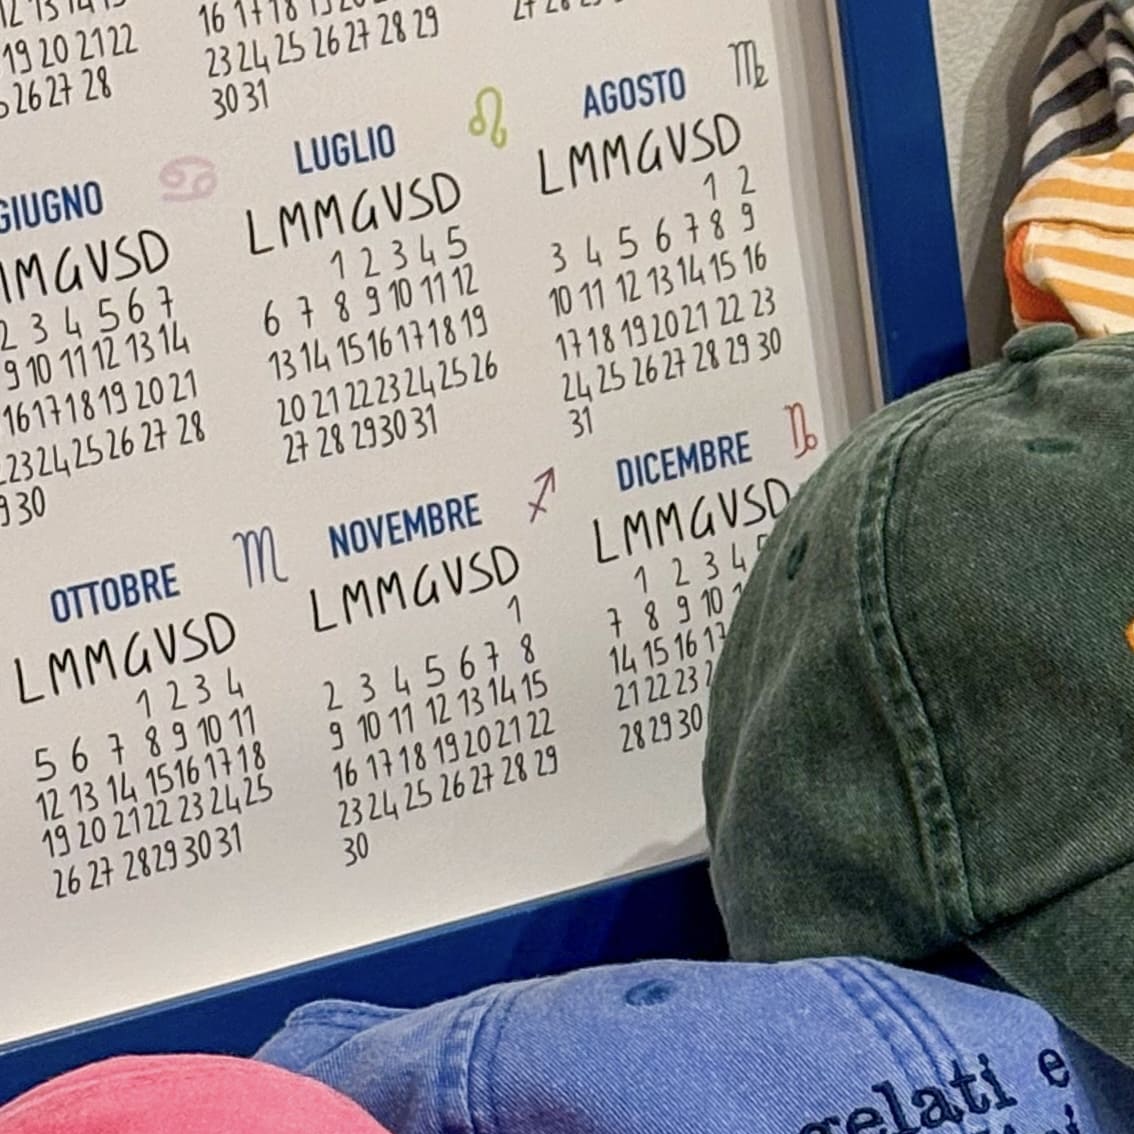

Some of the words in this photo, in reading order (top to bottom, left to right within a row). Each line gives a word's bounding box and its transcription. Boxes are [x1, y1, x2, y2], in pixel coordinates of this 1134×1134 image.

[2, 39, 32, 74] 19
[39, 34, 68, 68] 20
[75, 27, 104, 61] 21
[107, 23, 138, 56] 22
[205, 45, 232, 78] 23
[237, 40, 270, 74] 24
[274, 30, 305, 65] 25
[313, 24, 340, 58] 26
[344, 18, 370, 53] 27
[377, 10, 406, 45] 28
[413, 5, 438, 39] 29
[13, 79, 41, 114] 26
[45, 72, 72, 108] 27
[81, 65, 112, 101] 28
[212, 83, 238, 120] 30
[242, 78, 268, 112] 31
[584, 67, 686, 119] AGOSTO
[294, 124, 395, 175] LUGLIO
[703, 172, 716, 200] 1
[738, 165, 756, 195] 2
[330, 250, 344, 280] 1
[360, 246, 381, 278] 2
[392, 240, 408, 270] 3
[420, 234, 436, 267] 4
[448, 225, 467, 259] 5
[551, 243, 566, 273] 3
[587, 235, 602, 267] 4
[619, 226, 638, 260] 5
[656, 217, 671, 253] 6
[684, 212, 699, 244] 7
[710, 208, 724, 240] 8
[741, 202, 755, 232] 9
[264, 300, 280, 337] 6
[297, 296, 313, 329] 7
[334, 290, 350, 323] 8
[366, 286, 381, 316] 9
[388, 278, 412, 311] 10
[420, 271, 446, 305] 11
[452, 262, 479, 296] 12
[549, 285, 572, 317] 10
[579, 278, 604, 311] 11
[616, 270, 641, 302] 12
[647, 265, 674, 296] 13
[677, 254, 706, 286] 14
[709, 250, 736, 283] 15
[743, 241, 767, 274] 16
[31, 313, 48, 344] 3
[65, 306, 82, 339] 4
[99, 298, 120, 333] 5
[128, 287, 144, 324] 6
[157, 286, 173, 319] 7
[4, 360, 20, 391] 9
[26, 353, 51, 387] 10
[59, 345, 87, 379] 11
[92, 336, 120, 370] 12
[125, 331, 155, 363] 13
[158, 321, 190, 355] 14
[268, 349, 297, 381] 13
[300, 338, 331, 373] 14
[337, 332, 365, 366] 15
[367, 326, 392, 361] 16
[397, 320, 423, 353] 17
[428, 315, 456, 348] 18
[461, 304, 488, 338] 19
[562, 371, 593, 402] 24
[597, 361, 625, 394] 25
[632, 354, 658, 386] 26
[662, 347, 686, 380] 27
[692, 339, 720, 372] 28
[725, 333, 749, 365] 29
[757, 327, 781, 361] 30
[6, 451, 33, 483] 23
[36, 444, 71, 478] 24
[72, 434, 103, 469] 25
[106, 426, 134, 460] 26
[141, 418, 167, 453] 27
[176, 410, 205, 445] 28
[568, 406, 592, 438] 31
[616, 430, 752, 492] DICEMBRE
[16, 486, 45, 526] 30
[328, 493, 483, 559] NOVEMBRE
[50, 563, 181, 623] OTTOBRE
[634, 566, 647, 594] 1
[672, 557, 690, 587] 2
[704, 551, 719, 580] 3
[732, 542, 746, 572] 4
[507, 595, 521, 624] 1
[607, 608, 622, 638] 7
[644, 600, 659, 631] 8
[677, 595, 690, 624] 9
[701, 586, 723, 618] 10
[323, 681, 343, 711] 2
[360, 673, 376, 703] 3
[395, 665, 410, 696] 4
[426, 654, 445, 688] 5
[460, 645, 475, 680] 6
[484, 641, 499, 672] 7
[520, 633, 535, 664] 8
[609, 644, 637, 675] 14
[643, 636, 669, 668] 15
[674, 629, 697, 661] 16
[136, 689, 151, 719] 1
[166, 680, 187, 711] 2
[194, 674, 211, 704] 3
[227, 667, 244, 698] 4
[329, 722, 344, 751] 9
[357, 711, 381, 743] 10
[388, 702, 413, 735] 11
[426, 693, 452, 725] 12
[457, 687, 484, 717] 13
[488, 675, 517, 706] 14
[521, 669, 548, 701] 15
[614, 680, 639, 711] 21
[645, 673, 671, 703] 22
[675, 666, 698, 695] 23
[35, 748, 56, 782] 5
[72, 736, 88, 773] 6
[108, 733, 124, 765] 7
[145, 725, 161, 757] 8
[172, 722, 187, 752] 9
[197, 714, 222, 747] 10
[229, 704, 255, 737] 11
[620, 720, 645, 753] 28
[649, 712, 672, 743] 29
[678, 703, 702, 739] 30
[53, 865, 80, 899] 26
[88, 856, 114, 890] 27
[123, 847, 151, 881] 28
[152, 840, 177, 872] 29
[183, 830, 211, 868] 30
[215, 822, 241, 858] 31
[344, 832, 368, 867] 30
[1037, 1048, 1071, 1089] e
